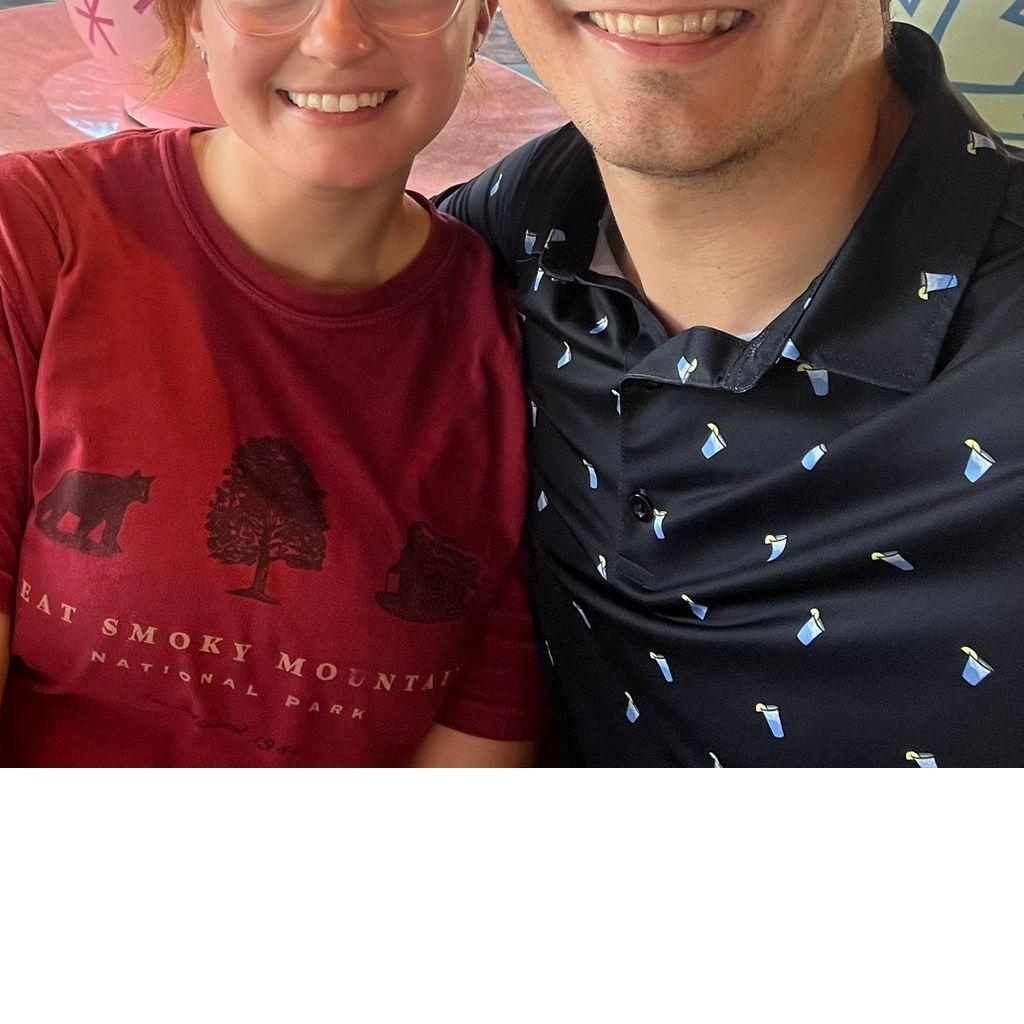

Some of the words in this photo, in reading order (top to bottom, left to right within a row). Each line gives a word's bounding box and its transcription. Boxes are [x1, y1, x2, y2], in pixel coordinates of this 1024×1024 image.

[20, 579, 77, 623] EAT
[102, 618, 252, 662] SMOKY
[275, 652, 459, 692] MOUNTAI
[91, 651, 258, 696] NATIONAL
[285, 695, 365, 719] PARK
